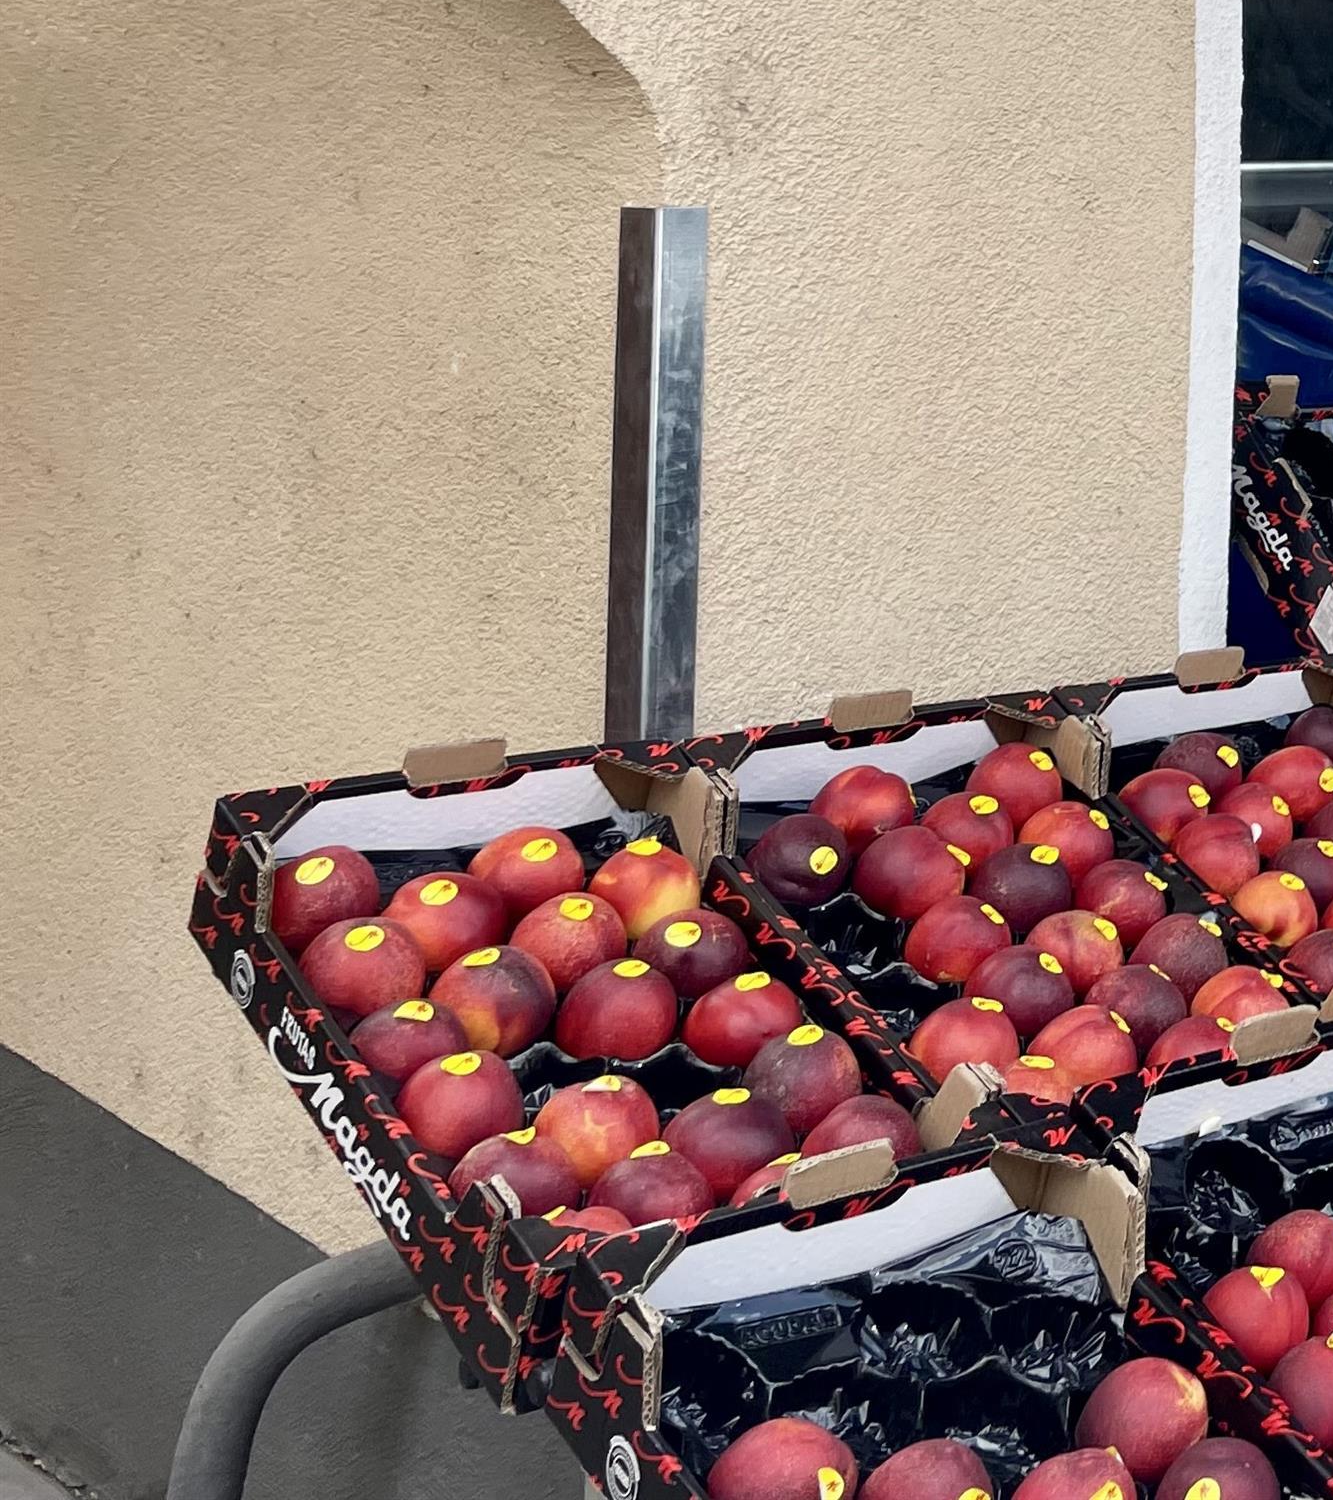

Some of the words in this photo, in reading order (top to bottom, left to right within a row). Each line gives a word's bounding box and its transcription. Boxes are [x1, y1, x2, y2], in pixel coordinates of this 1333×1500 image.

[1232, 464, 1293, 571] Magda
[280, 1005, 317, 1071] FRUTAS
[267, 1025, 412, 1242] Magda
